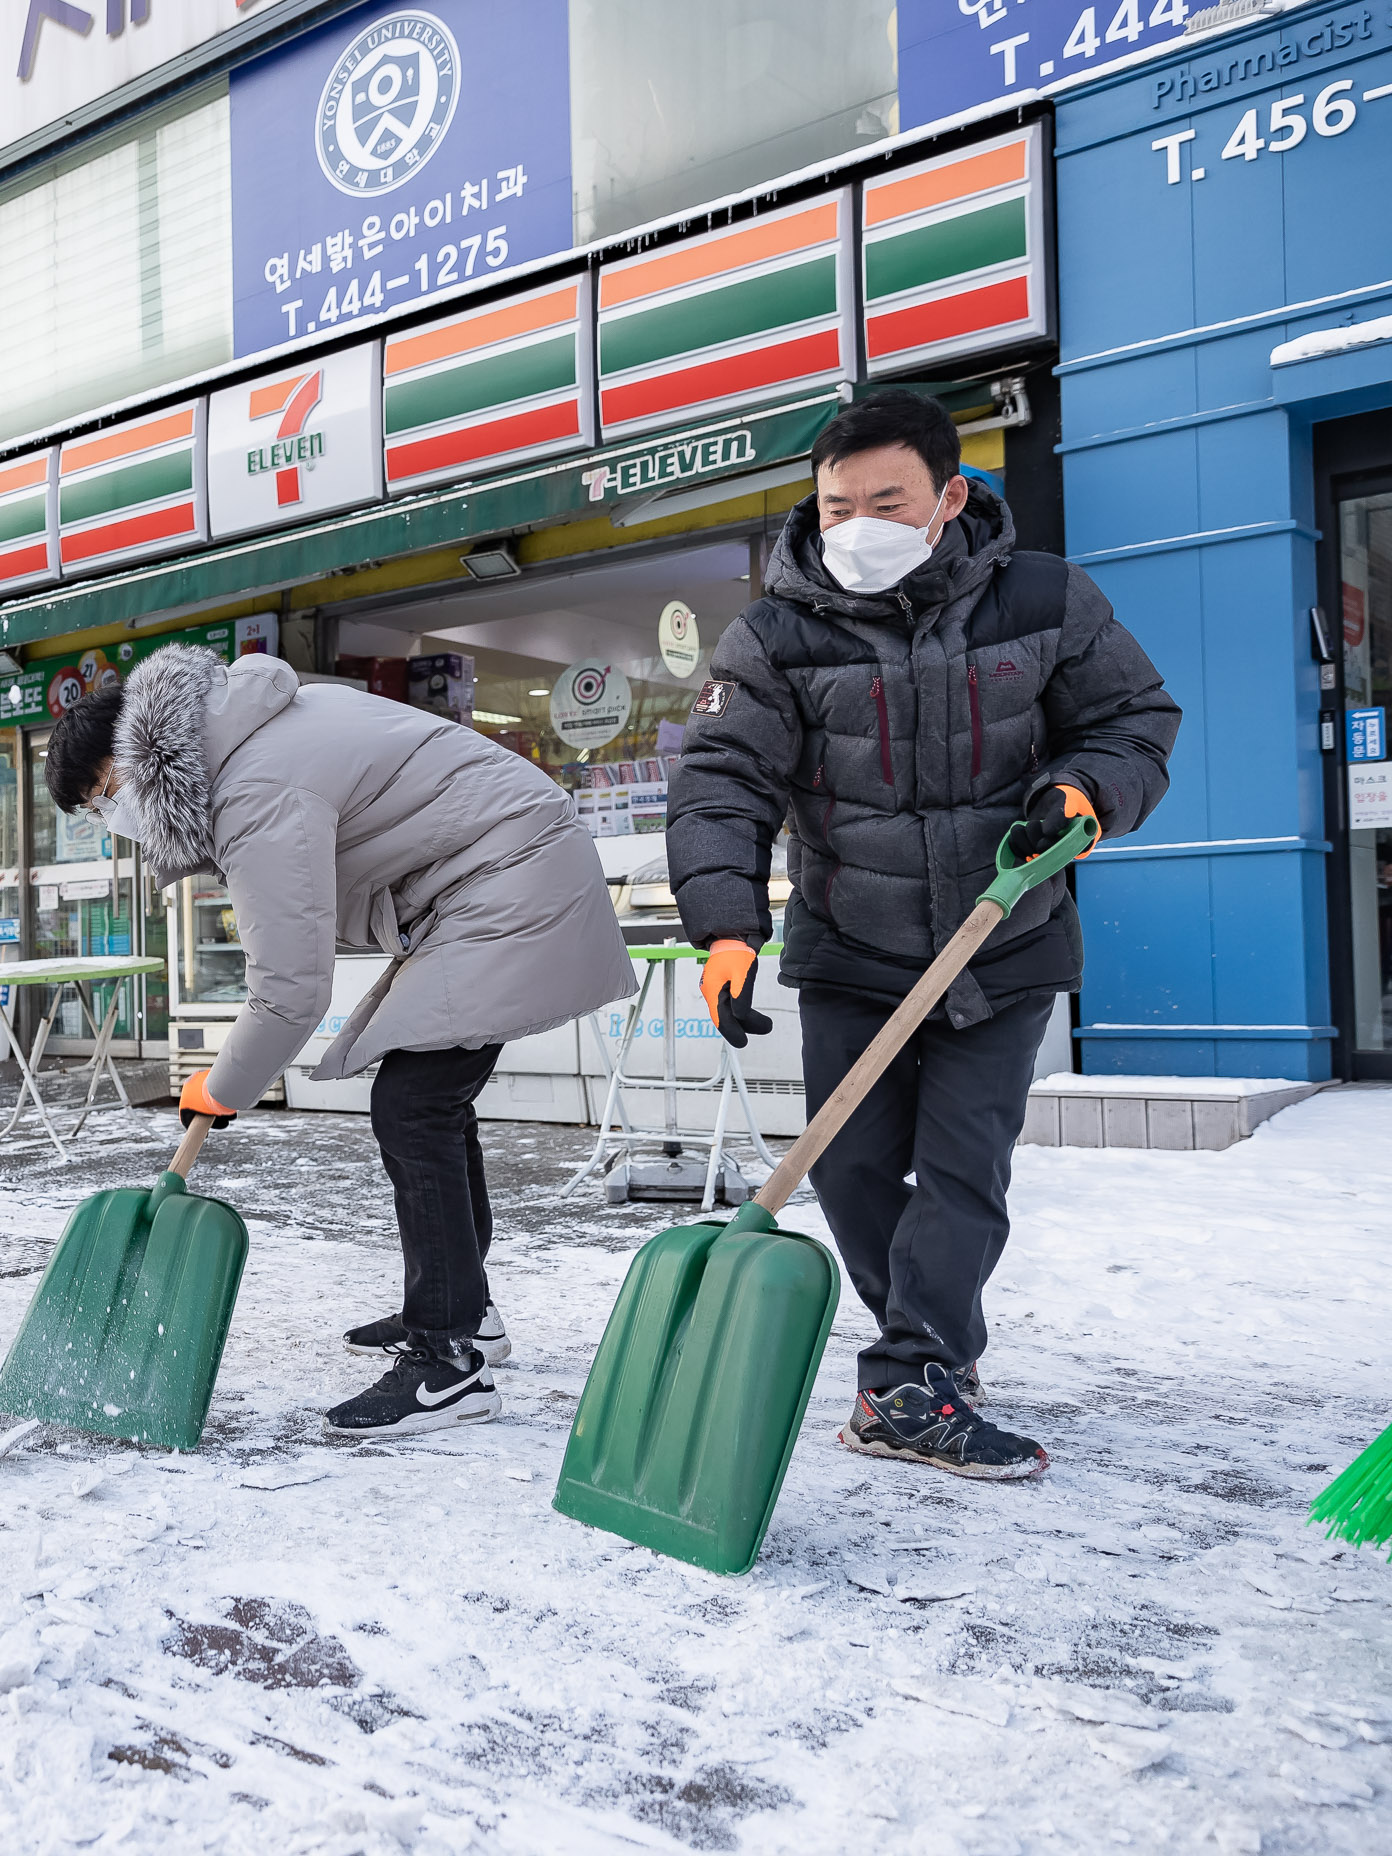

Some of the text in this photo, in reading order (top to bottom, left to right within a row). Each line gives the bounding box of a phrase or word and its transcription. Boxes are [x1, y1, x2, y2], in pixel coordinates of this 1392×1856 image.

[322, 20, 453, 132] YONSEI UNIVERSITY
[1153, 10, 1372, 110] Pharmacist
[249, 369, 322, 507] 7
[63, 682, 79, 704] 20
[82, 663, 94, 682] 21
[648, 1018, 721, 1039] ceam
